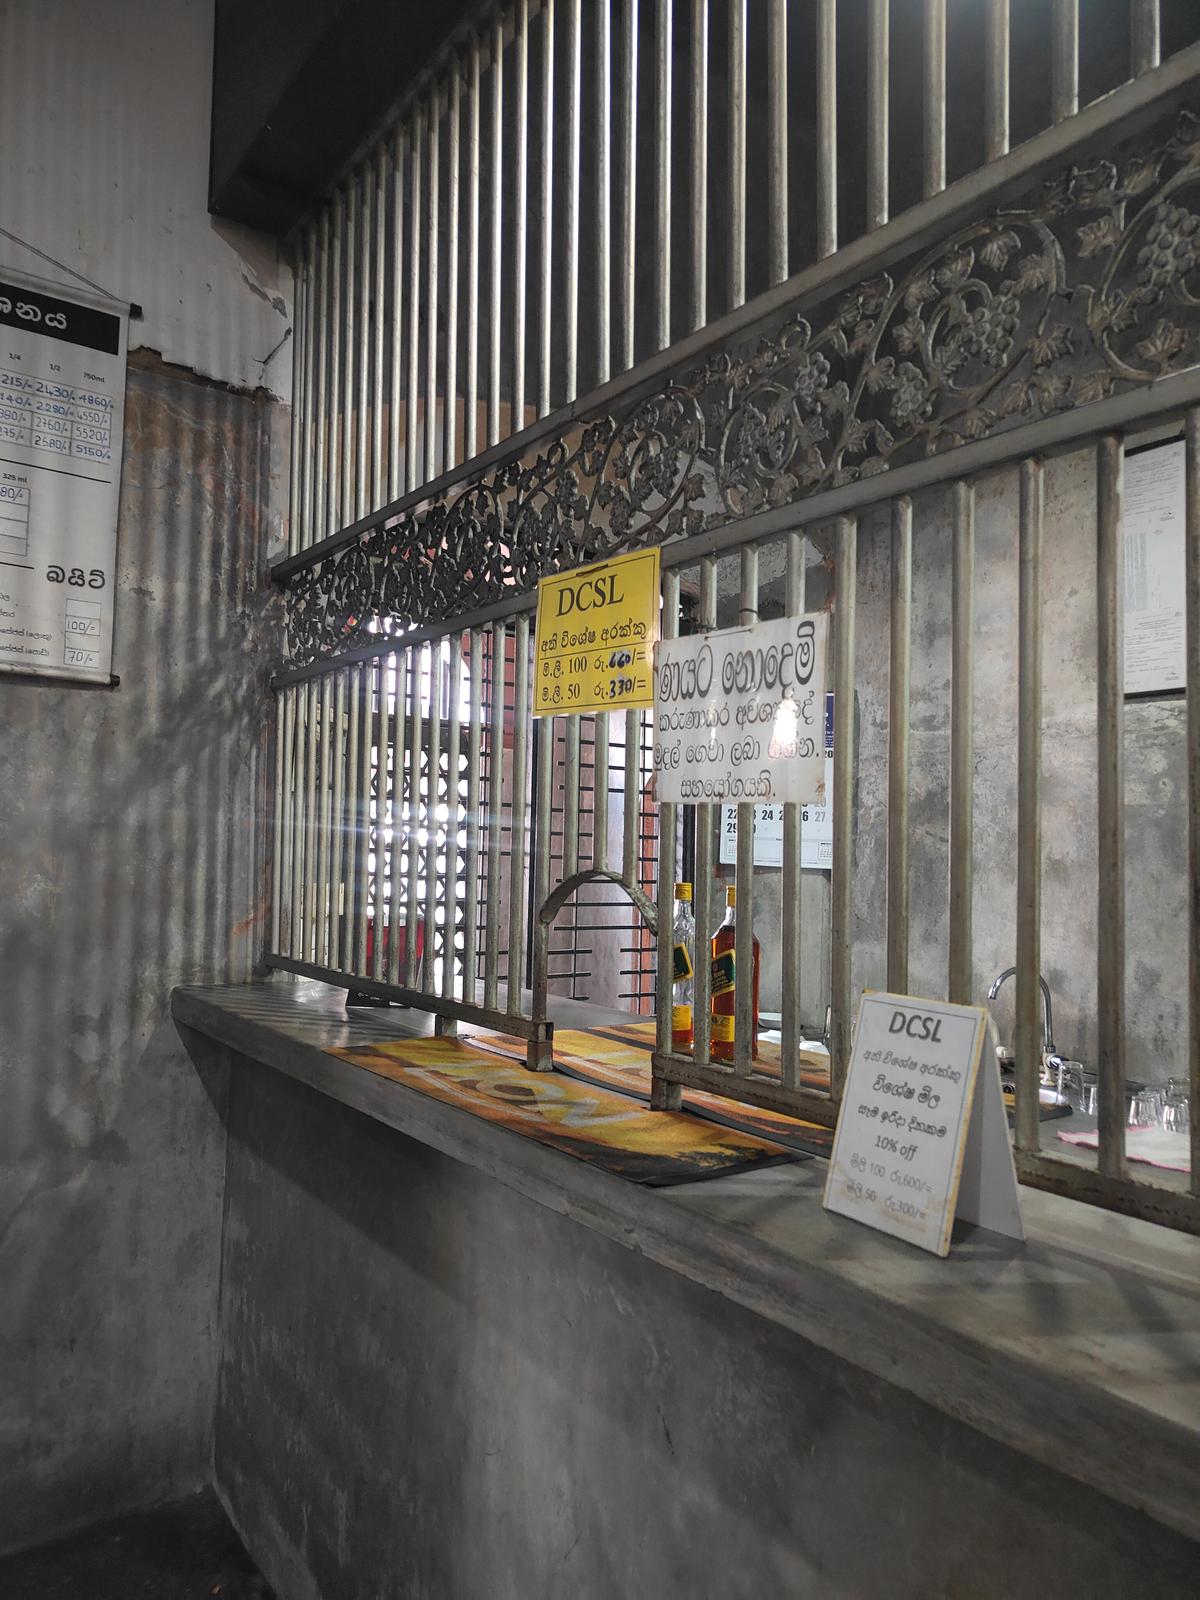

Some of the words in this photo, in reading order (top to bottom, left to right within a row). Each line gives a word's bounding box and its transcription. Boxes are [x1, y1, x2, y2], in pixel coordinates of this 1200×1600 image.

[556, 574, 624, 617] DCSL
[67, 620, 96, 635] 100/=
[541, 633, 557, 656] අති
[561, 627, 596, 648] විශේෂ
[601, 618, 646, 648] අරක්කු
[67, 650, 93, 664] 70/=
[569, 656, 587, 674] 100
[568, 684, 580, 700] 50
[730, 735, 760, 767] ලබා
[762, 810, 773, 820] 24
[815, 811, 825, 822] 27
[888, 1011, 943, 1043] DCSL
[872, 1074, 915, 1099] විශේෂ
[874, 1136, 897, 1153] 10%
[900, 1146, 918, 1161] off
[870, 1163, 885, 1178] 100
[865, 1188, 877, 1202] 50
